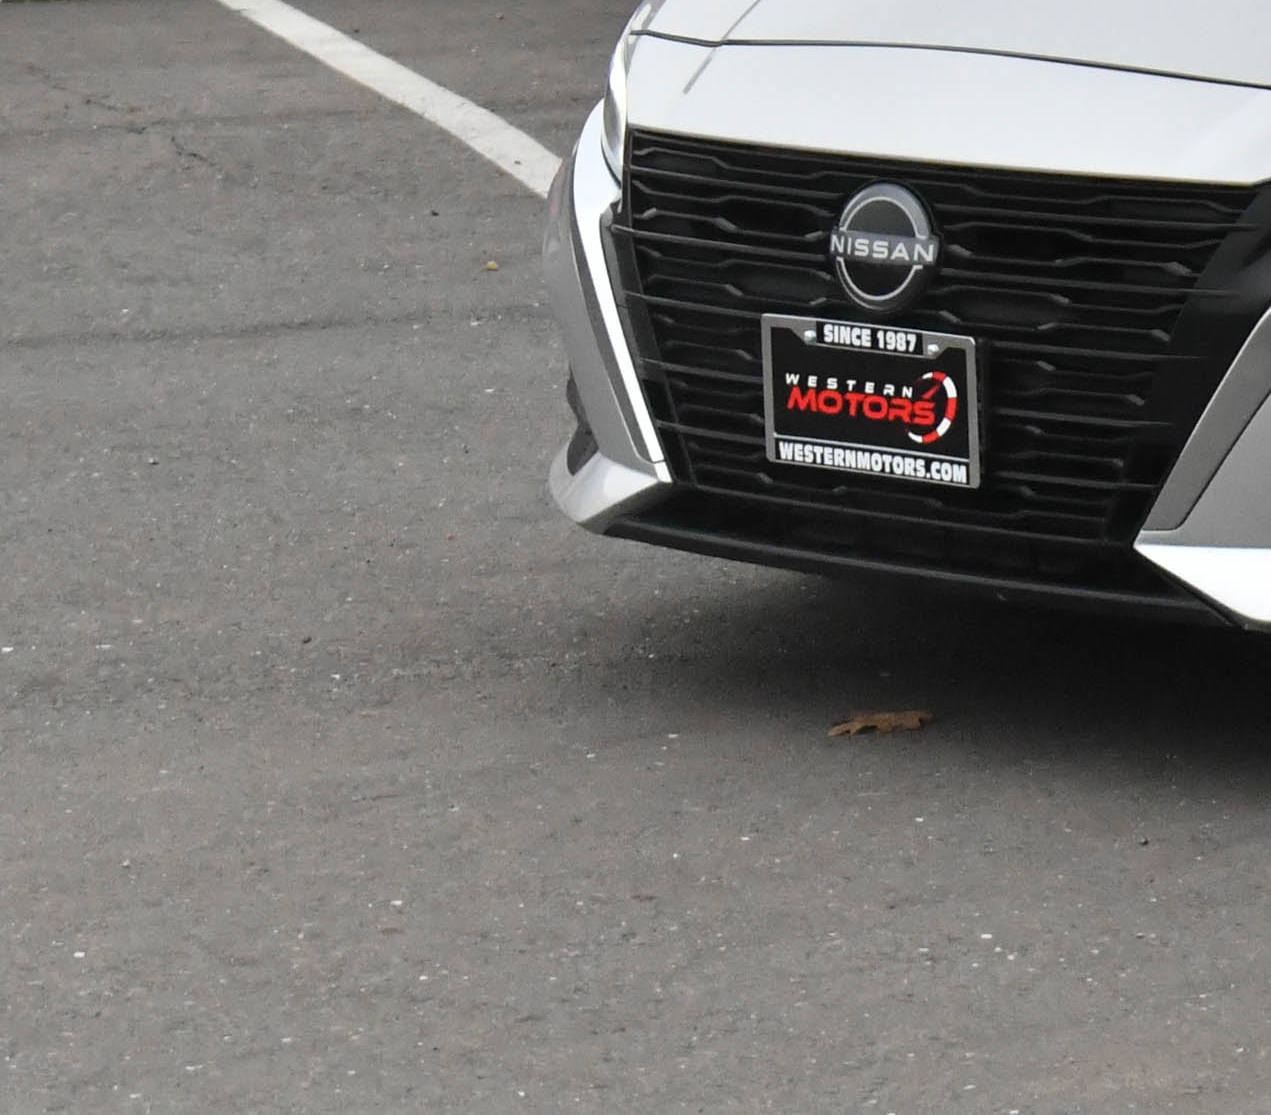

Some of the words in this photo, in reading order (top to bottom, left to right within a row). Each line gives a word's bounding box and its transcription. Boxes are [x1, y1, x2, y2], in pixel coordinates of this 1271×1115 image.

[830, 233, 935, 262] NISSAN
[823, 323, 872, 348] SINCE
[877, 329, 917, 353] 1987
[785, 373, 913, 399] WESTERN
[786, 385, 936, 426] MOTORS
[778, 440, 968, 484] WESTERNMOTORS.COM
